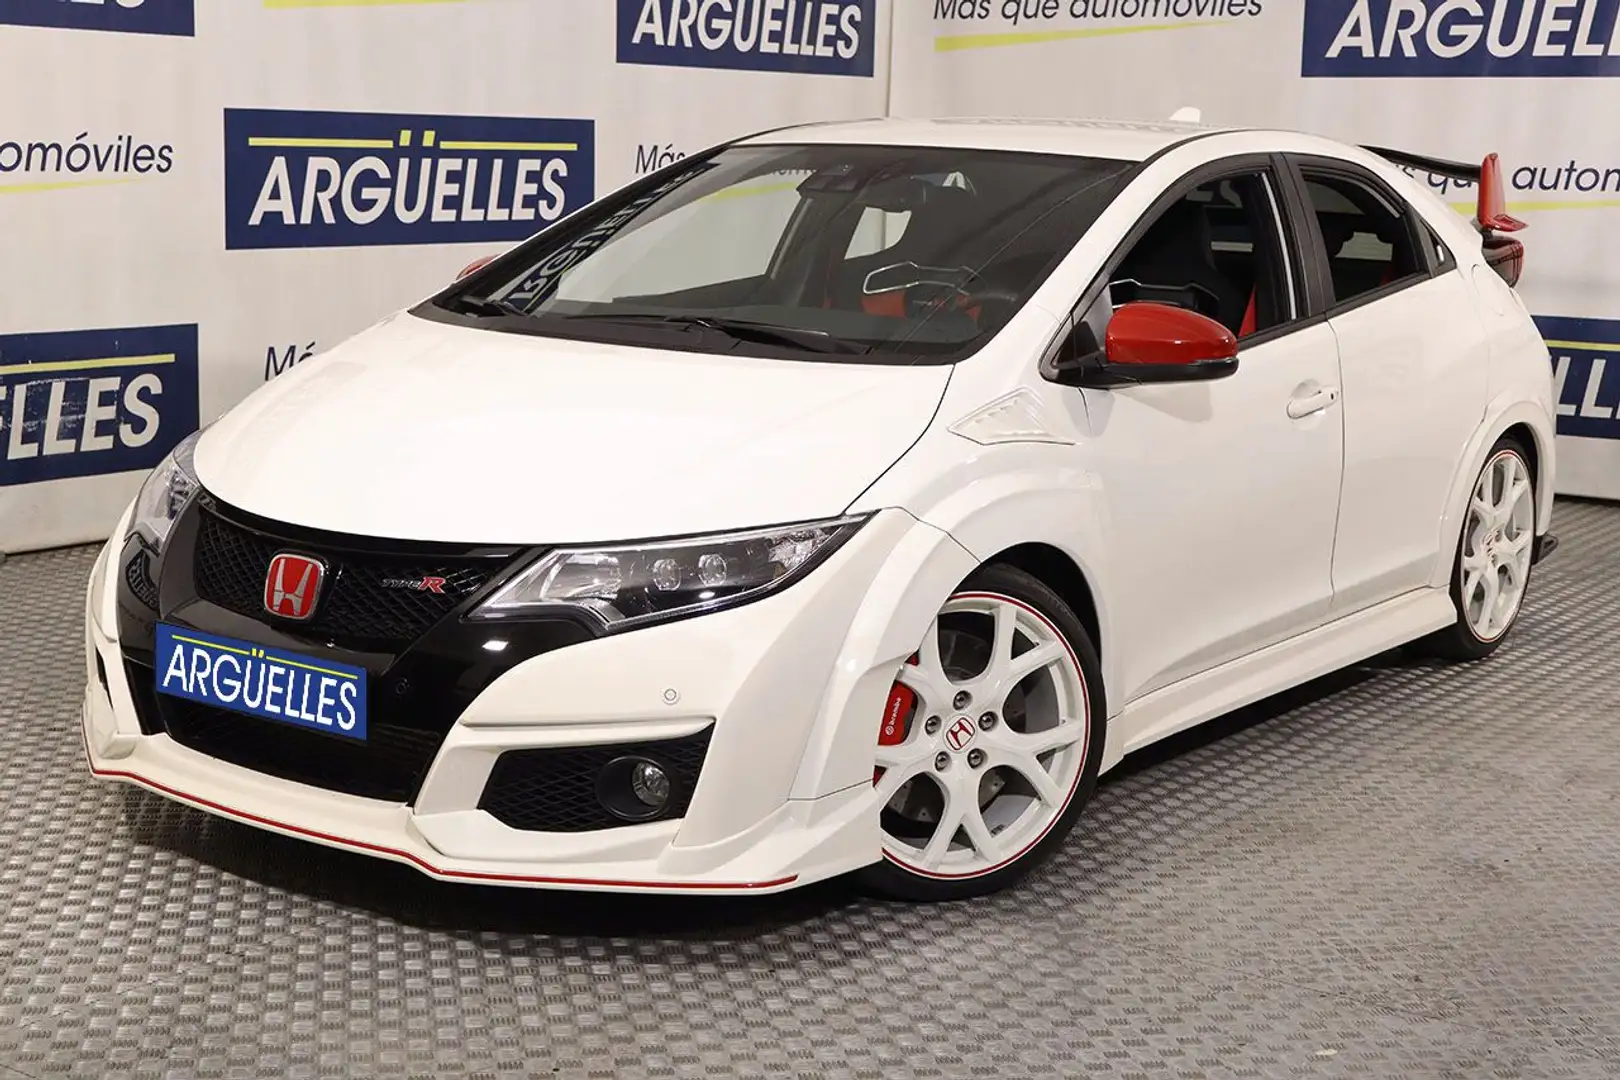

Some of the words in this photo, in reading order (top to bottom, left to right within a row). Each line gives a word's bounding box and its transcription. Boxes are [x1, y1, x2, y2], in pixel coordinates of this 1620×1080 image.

[1001, 0, 1059, 25] que
[0, 132, 174, 173] omóviles
[248, 130, 568, 225] ARGÜELLES
[0, 373, 163, 460] LLES
[1553, 356, 1620, 419] LL
